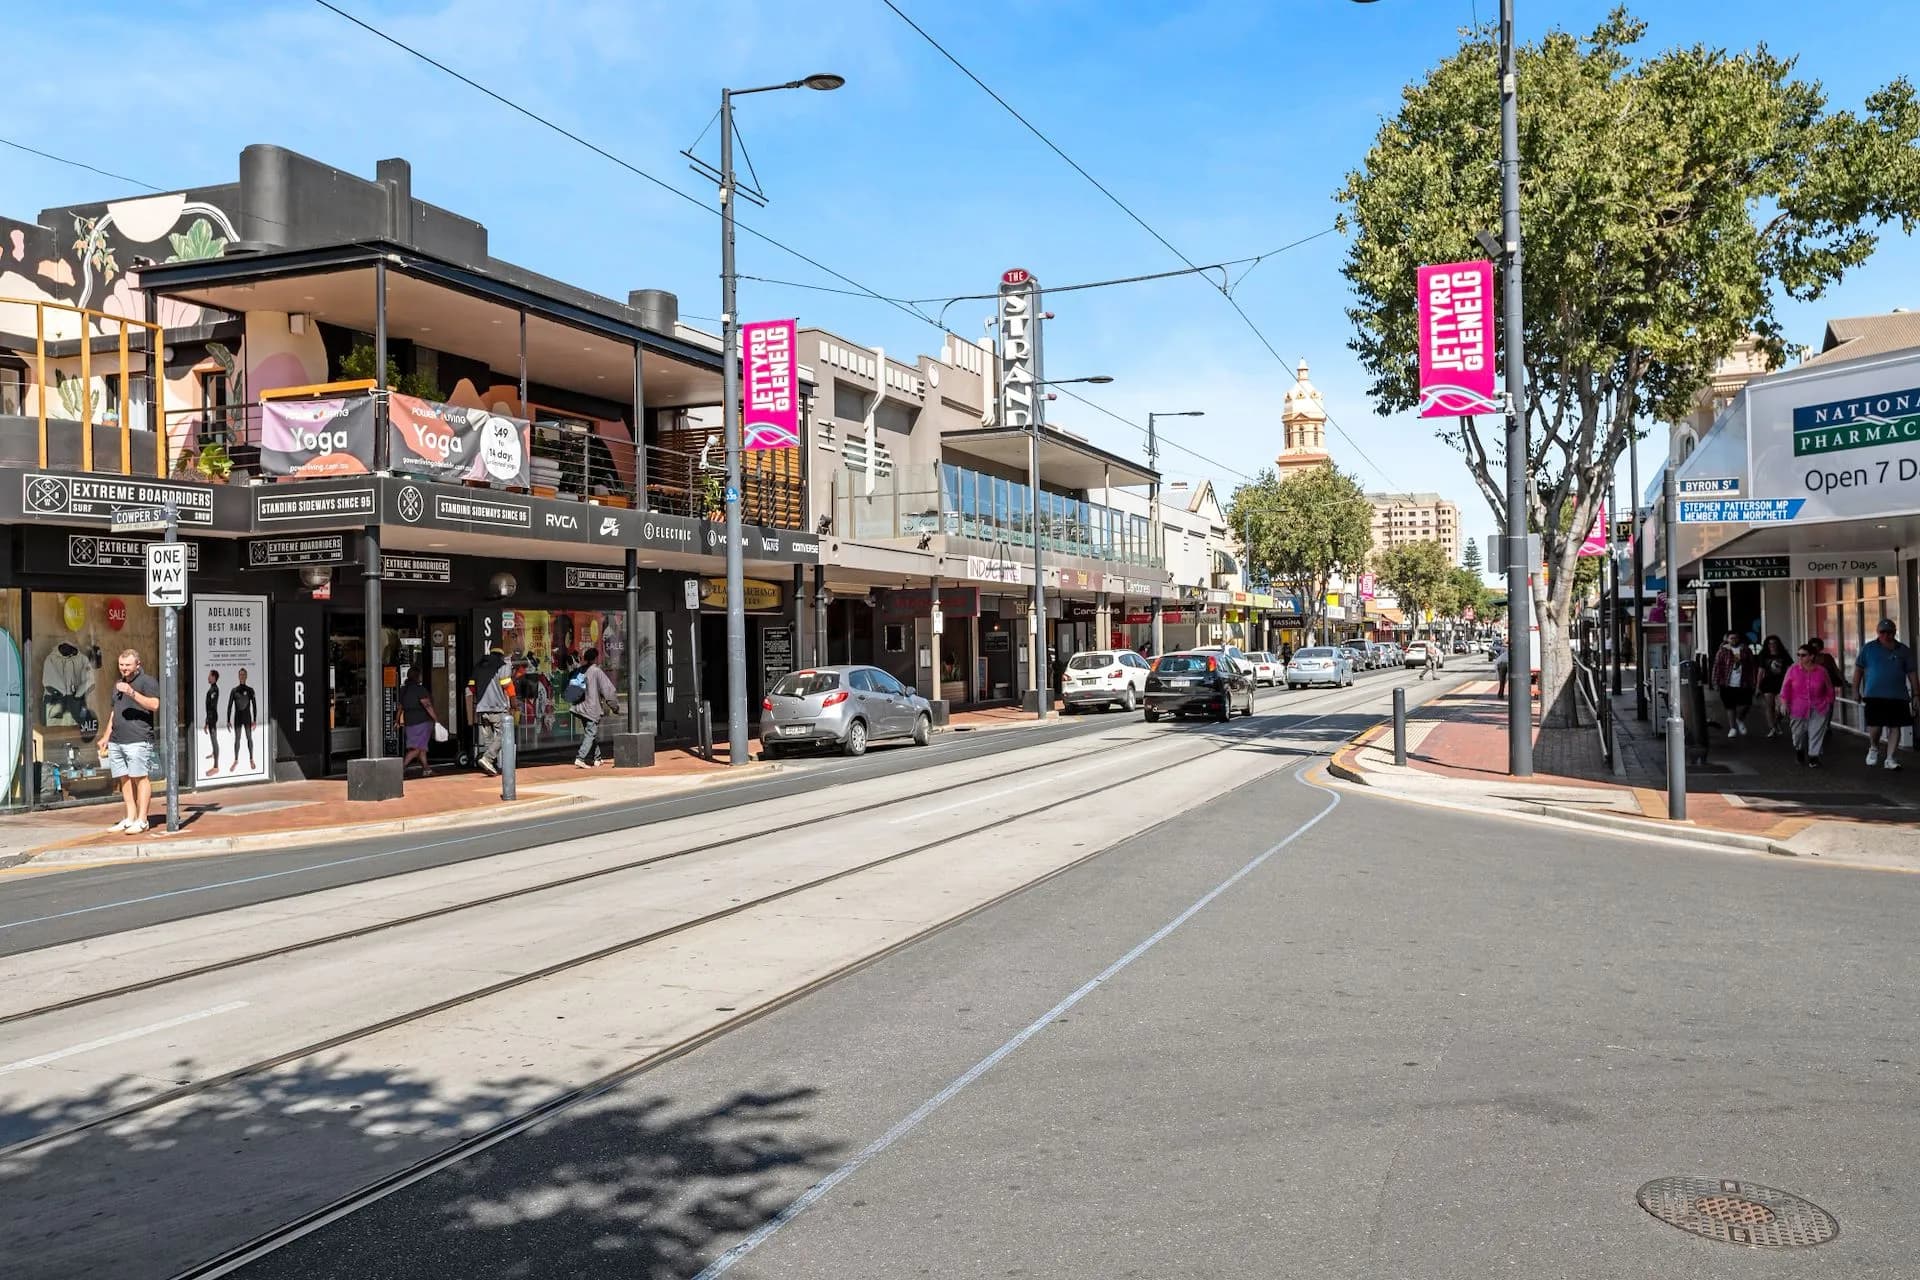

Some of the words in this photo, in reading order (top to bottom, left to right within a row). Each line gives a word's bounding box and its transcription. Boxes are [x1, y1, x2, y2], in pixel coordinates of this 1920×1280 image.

[1007, 271, 1023, 282] THE
[1452, 270, 1484, 371] GLENELG
[1003, 290, 1034, 428] STRAND
[767, 326, 790, 411] GLENELG
[411, 407, 437, 419] POWER
[1815, 395, 1920, 423] NATION
[290, 427, 348, 457] Yoga
[413, 423, 463, 458] Yoga
[1800, 421, 1917, 450] PHARMAC
[489, 448, 496, 457] 14
[1805, 468, 1867, 495] Open
[1875, 461, 1889, 484] 7
[1899, 458, 1920, 481] D
[1686, 480, 1718, 491] BYRON
[73, 482, 135, 500] EXTREME
[139, 486, 211, 506] BOARDRIDERS
[73, 503, 93, 513] SURF
[261, 501, 297, 514] STANDING
[299, 498, 336, 512] SIDEWAYS
[337, 497, 359, 509] SINCE
[361, 496, 371, 507] 95
[440, 502, 471, 516] STANDING
[472, 506, 501, 519] SIDEWAYS
[501, 509, 518, 521] SINCE
[1684, 502, 1720, 512] STEPHEN
[1724, 501, 1771, 511] PATTERSON
[1776, 500, 1789, 510] MP
[116, 510, 150, 524] COWPER
[545, 513, 578, 529] RVCA
[1685, 511, 1718, 521] MEMBER
[1723, 511, 1738, 520] FOR
[1743, 510, 1788, 520] MORPHETT
[655, 526, 692, 541] ELECTRIC
[99, 541, 140, 554] EXTREME
[269, 542, 299, 553] EXTREME
[299, 539, 341, 550] BOARDRIDERS
[761, 537, 780, 551] VANS
[792, 542, 819, 554] CONVERSE
[153, 549, 181, 564] ONE
[386, 558, 412, 569] EXTREME
[1714, 558, 1778, 568] NATIONAL
[970, 559, 1020, 582] INDOCINE
[1707, 569, 1788, 578] PHARMACIES
[1807, 561, 1838, 573] Open
[1840, 560, 1847, 570] 7
[1850, 560, 1878, 572] Days
[151, 568, 182, 583] WAY
[108, 608, 126, 621] SALE
[208, 607, 251, 617] ADELAIDE'S
[208, 622, 225, 632] BEST
[230, 622, 252, 632] RANGE
[208, 637, 217, 646] OF
[219, 637, 252, 646] WETSUITS
[605, 642, 625, 650] SALE
[666, 628, 675, 704] SNOW
[294, 625, 304, 733] SURF
[80, 719, 98, 733] SALE
